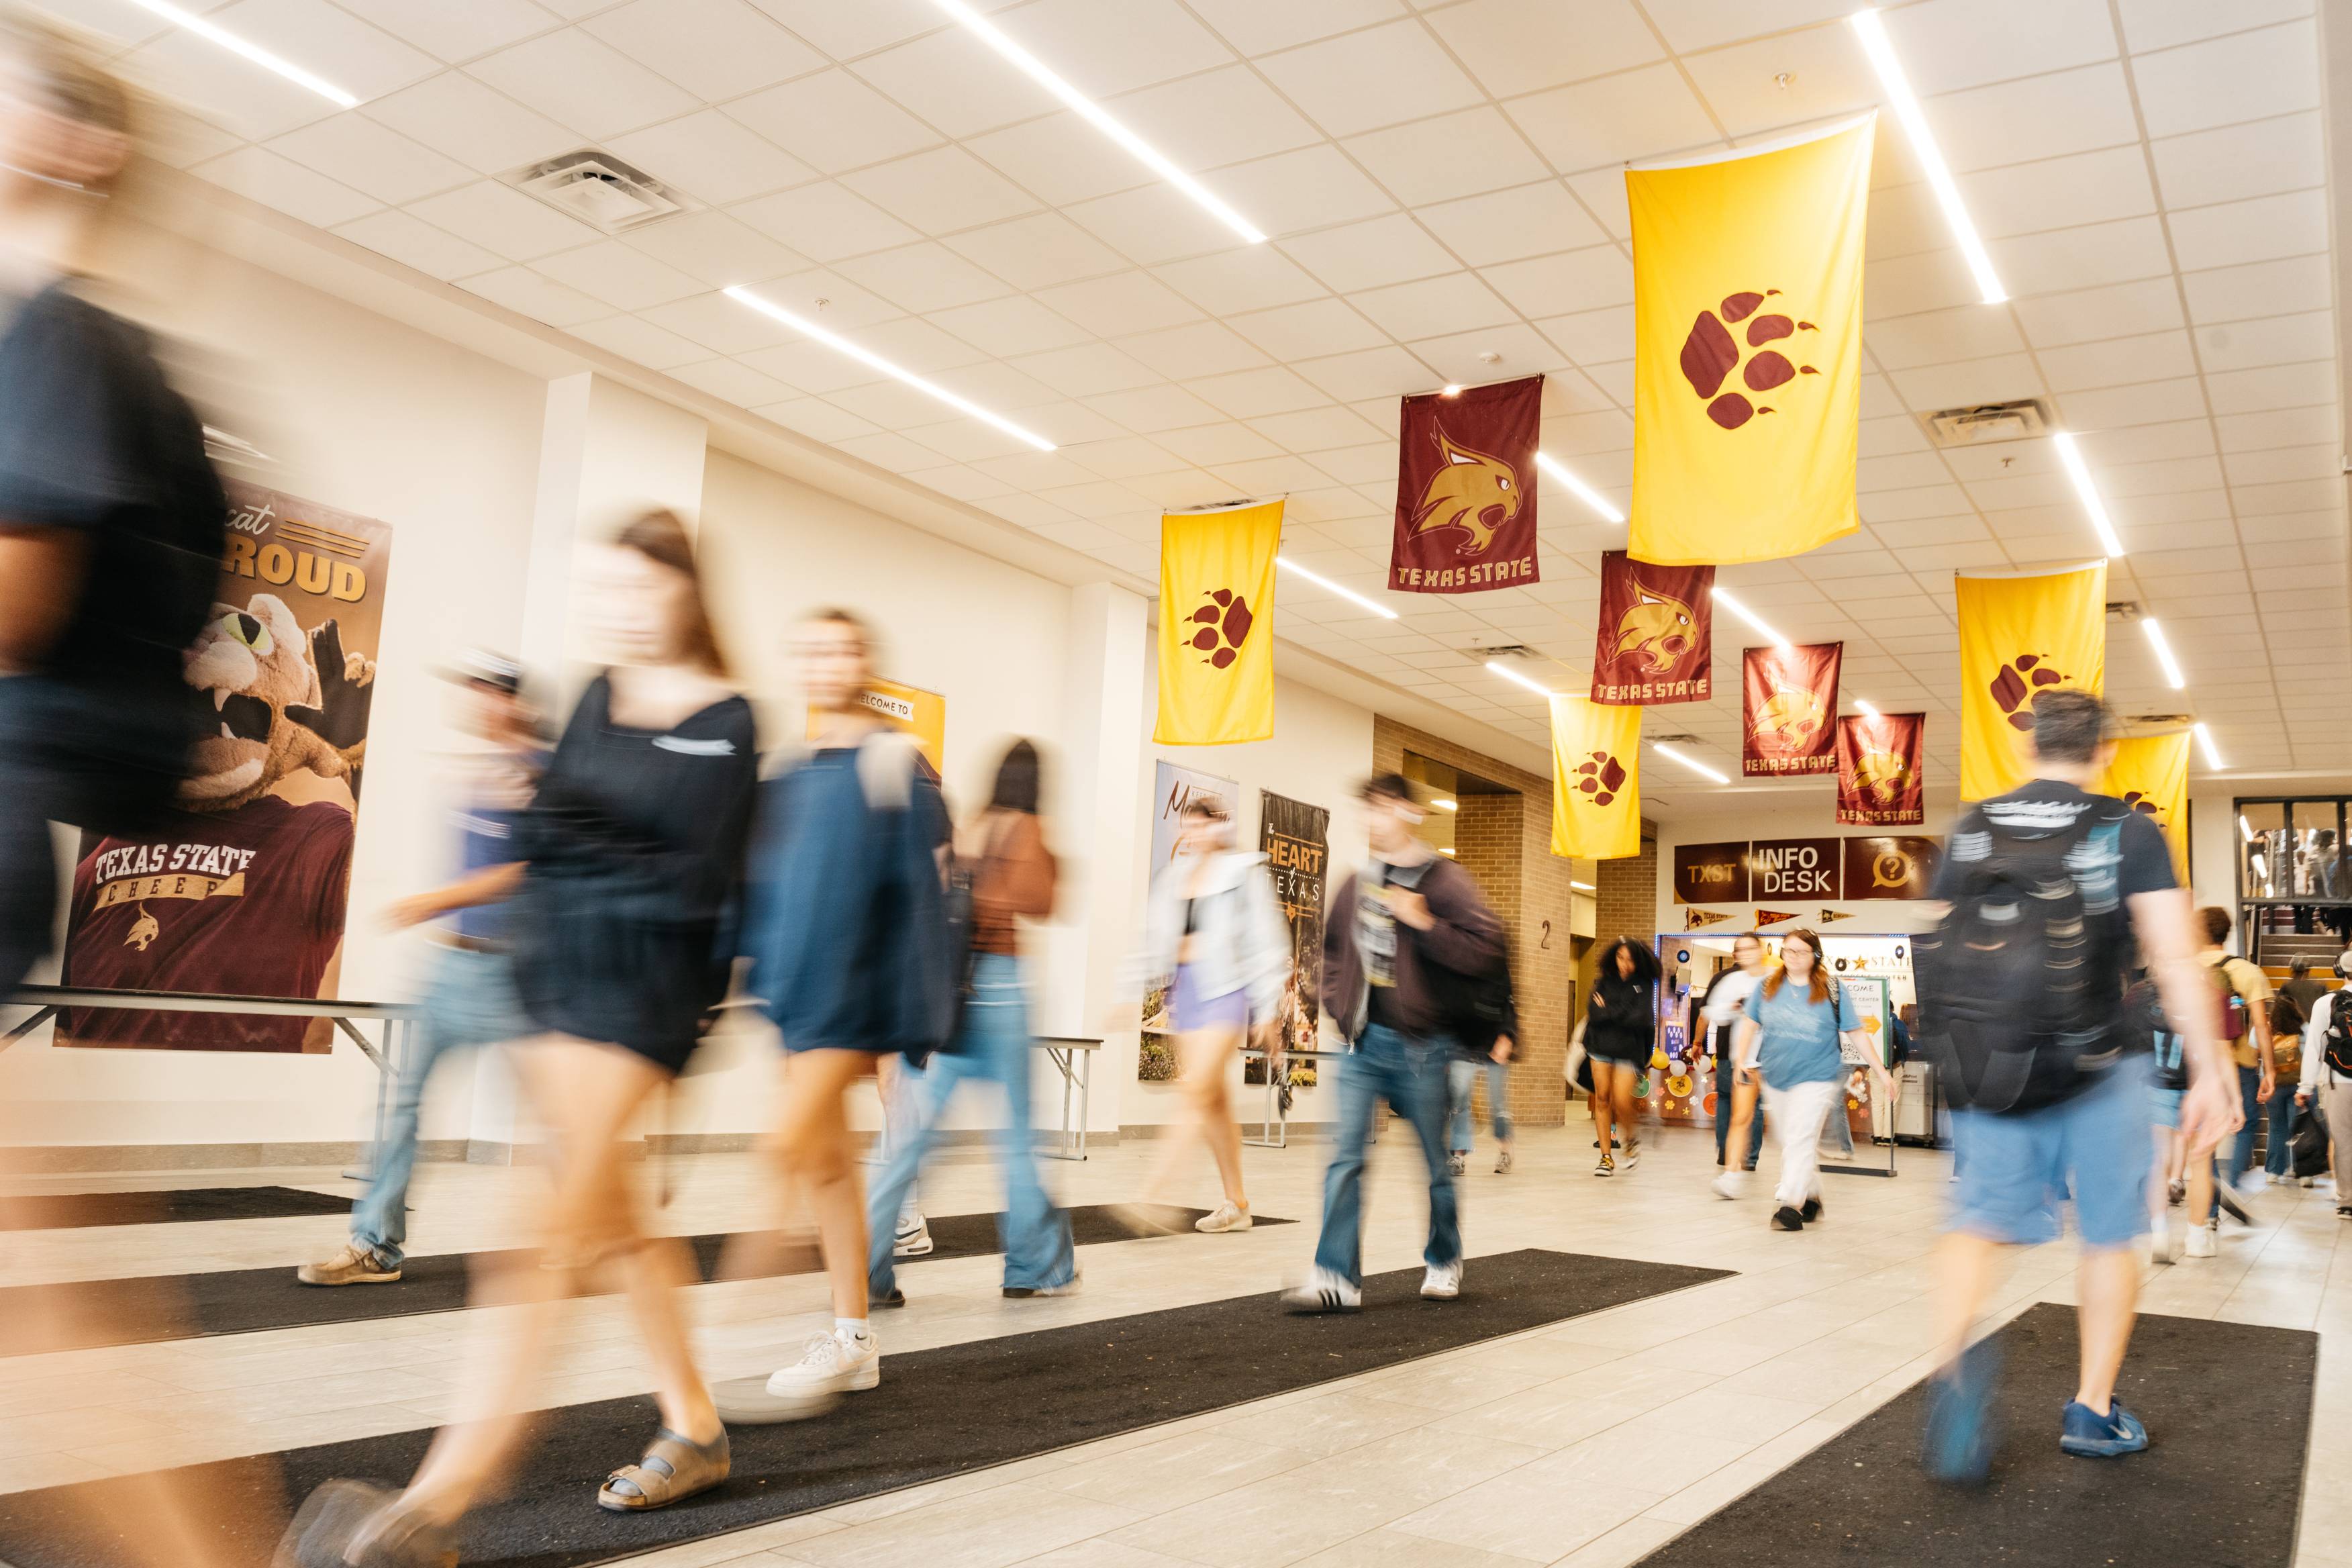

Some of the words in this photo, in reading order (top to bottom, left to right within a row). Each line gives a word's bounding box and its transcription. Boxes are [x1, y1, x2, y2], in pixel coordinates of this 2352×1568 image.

[224, 505, 275, 535] cat
[223, 532, 367, 603] ROUD
[1398, 567, 1465, 587] TEXAS
[1469, 556, 1532, 584] STATE
[1598, 683, 1652, 700] TEXAS
[1656, 679, 1707, 697] STATE
[861, 694, 896, 712] ELCOME
[898, 704, 908, 715] TO
[1746, 758, 1788, 771] TEXAS
[1790, 755, 1836, 770] STATE
[1841, 809, 1881, 822] TEXAS
[1883, 810, 1921, 822] STATE
[95, 844, 168, 885] TEXAS
[168, 844, 256, 877] STATE
[1267, 838, 1323, 874] HEART
[1759, 846, 1818, 870] INFO
[1687, 863, 1736, 883] TXST
[1765, 870, 1832, 893] DESK
[1267, 873, 1320, 901] TEXAS
[1541, 920, 1551, 950] 2
[1847, 985, 1875, 993] COME
